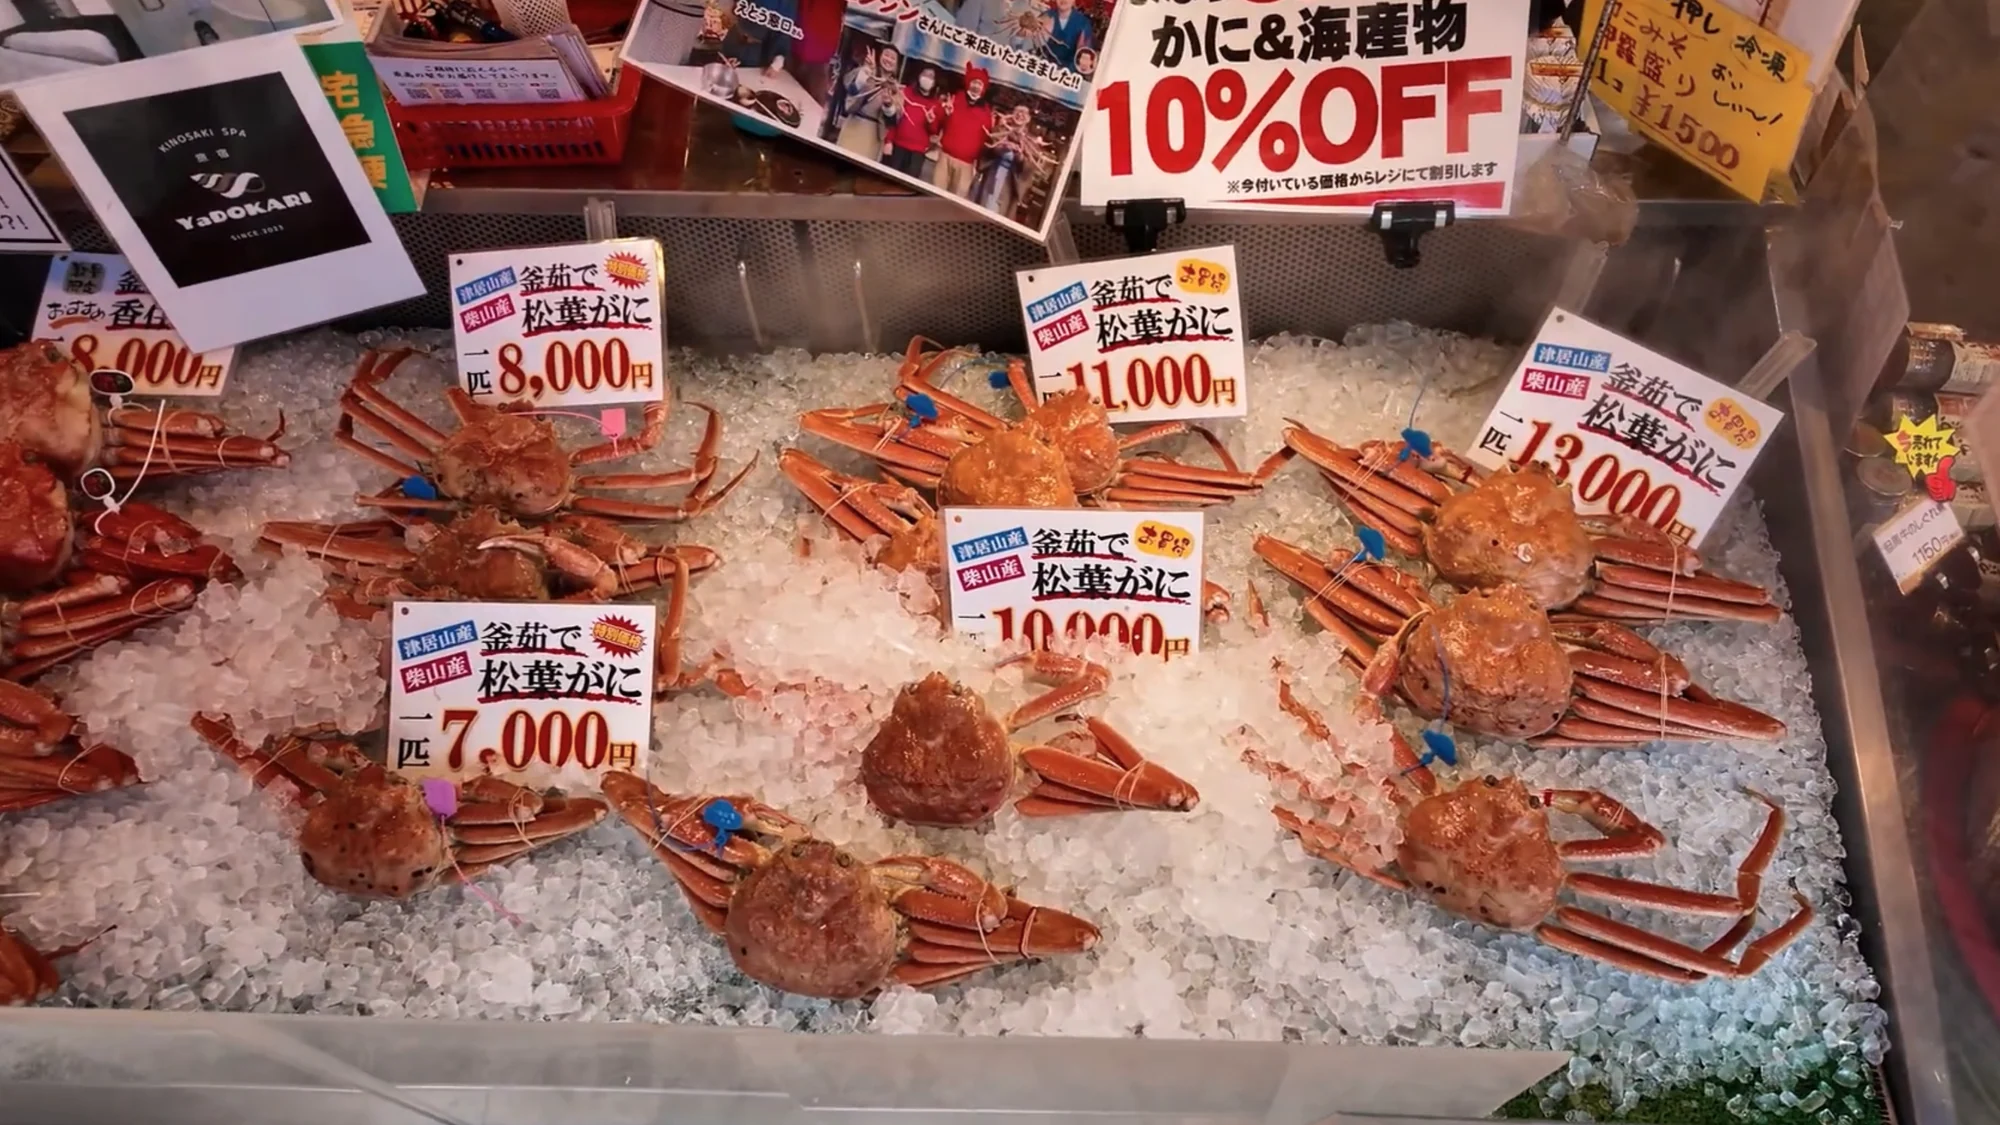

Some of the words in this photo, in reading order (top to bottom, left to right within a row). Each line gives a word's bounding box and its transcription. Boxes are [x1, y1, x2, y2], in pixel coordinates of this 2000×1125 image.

[1150, 3, 1467, 68] かに&海産物
[1734, 35, 1786, 82] 冷凍
[1096, 56, 1512, 177] 10%OFF
[1635, 84, 1740, 170] ¥1500
[158, 128, 214, 153] KINOSAKI
[221, 127, 248, 139] SPA
[1227, 161, 1498, 193] ※今付いている価格からレジにて割引します
[459, 268, 516, 304] 津居山産
[519, 262, 599, 293] 釜茹で
[1090, 273, 1173, 307] 釜茹で
[47, 299, 106, 321] おすすめ
[464, 297, 514, 329] 柴山産
[521, 294, 653, 332] 松葉がに
[1031, 284, 1087, 321] 津居山産
[1038, 314, 1089, 350] 柴山産
[1096, 304, 1234, 349] 松葉がに
[71, 334, 223, 388] 8000円
[498, 337, 653, 398] 8,000円
[1537, 345, 1610, 372] 津居山産
[1524, 371, 1589, 398] 柴山産
[1601, 361, 1704, 424] 釜茹で
[1581, 393, 1737, 490] 松葉がに
[1509, 420, 1697, 547] 13000円
[957, 531, 1024, 561] 津居山産
[1031, 527, 1131, 558] 釜茹で
[962, 558, 1024, 587] 柴山産
[1031, 562, 1191, 601] 松葉がに
[402, 624, 475, 658] 津居山産
[480, 621, 582, 653] 釜茹で
[592, 621, 644, 650] 特別価格
[405, 656, 470, 690] 柴山産
[479, 659, 642, 700] 松葉がに
